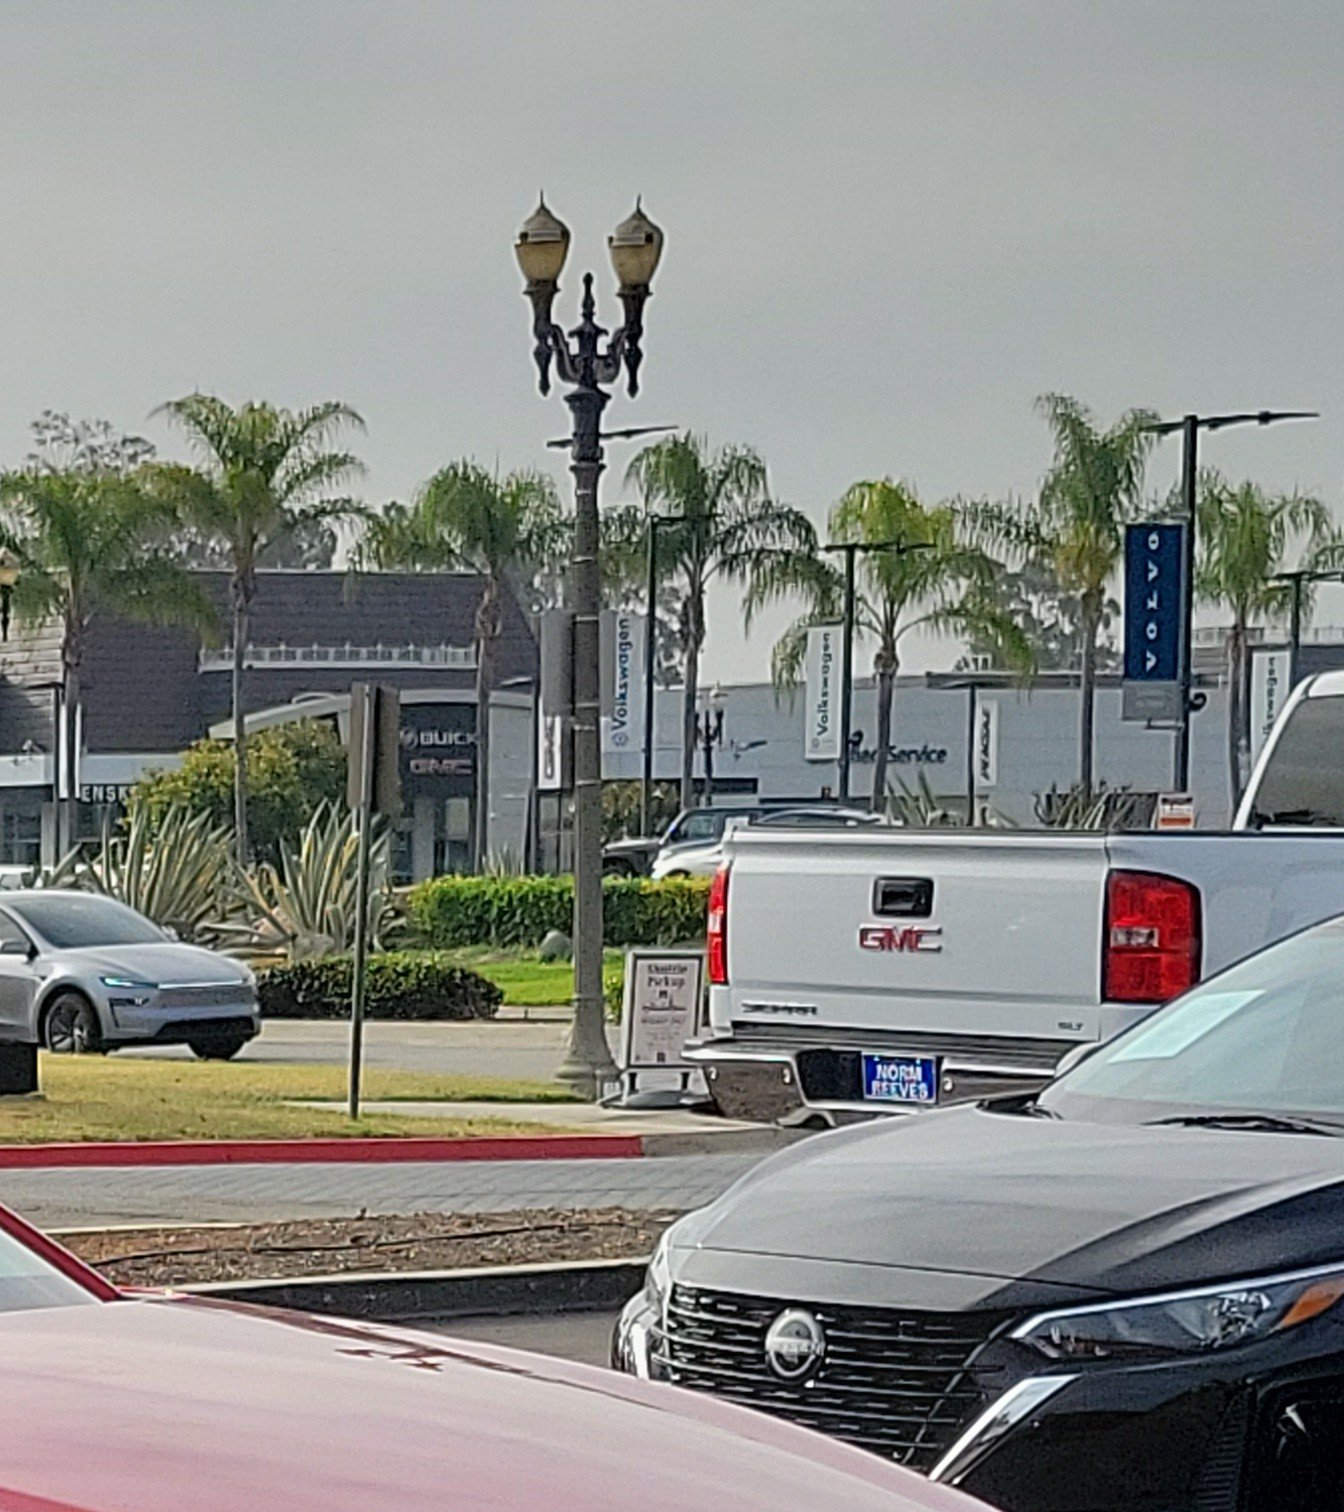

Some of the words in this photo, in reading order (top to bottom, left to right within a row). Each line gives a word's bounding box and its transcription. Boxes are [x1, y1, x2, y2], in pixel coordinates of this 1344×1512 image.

[1145, 532, 1160, 672] VOLVO
[611, 618, 633, 732] Volkswagen
[817, 632, 832, 736] Volkswagen
[859, 927, 943, 952] GMC
[871, 1080, 929, 1100] REEVES
[876, 1063, 923, 1082] NORM
